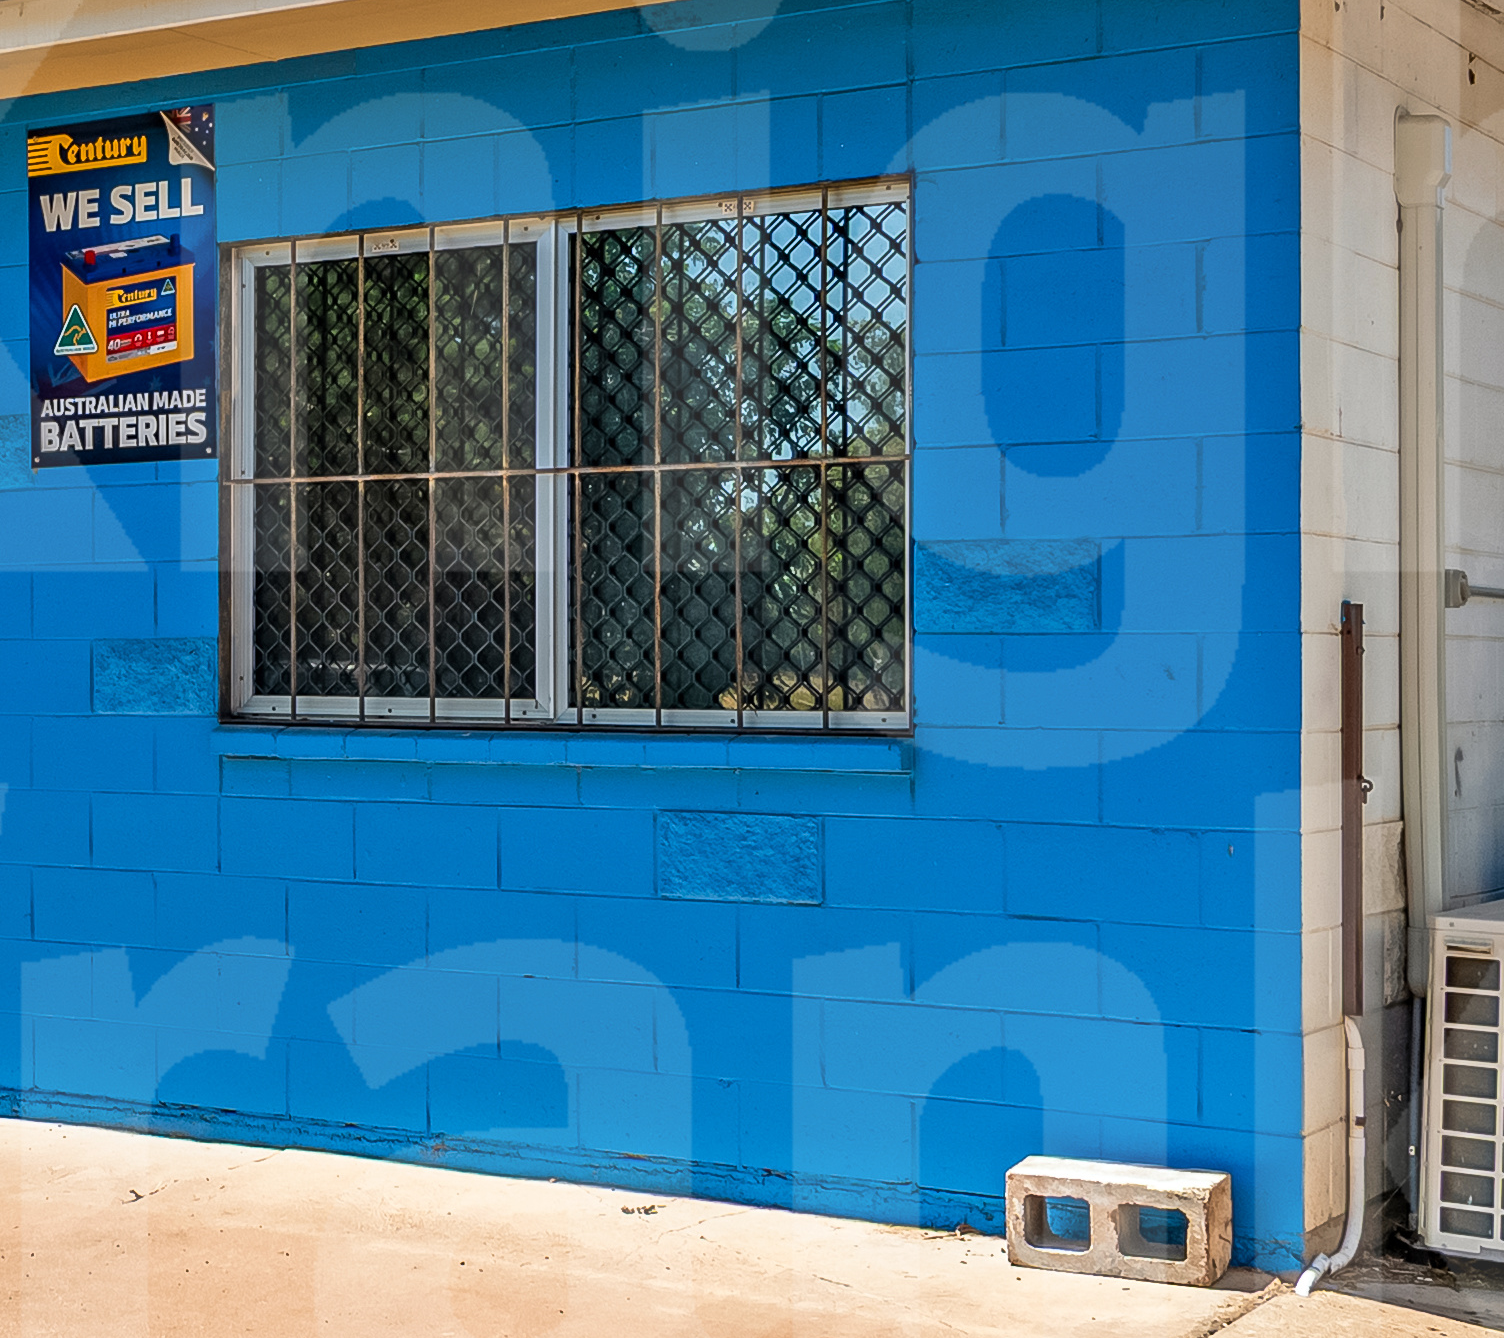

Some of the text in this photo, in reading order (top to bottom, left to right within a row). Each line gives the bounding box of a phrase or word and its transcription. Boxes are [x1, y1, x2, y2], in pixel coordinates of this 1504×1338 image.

[40, 134, 147, 175] Century
[39, 177, 204, 232] WE SELL
[41, 389, 206, 417] AUSTRALIAN MADE
[41, 411, 207, 452] BATTERIES
